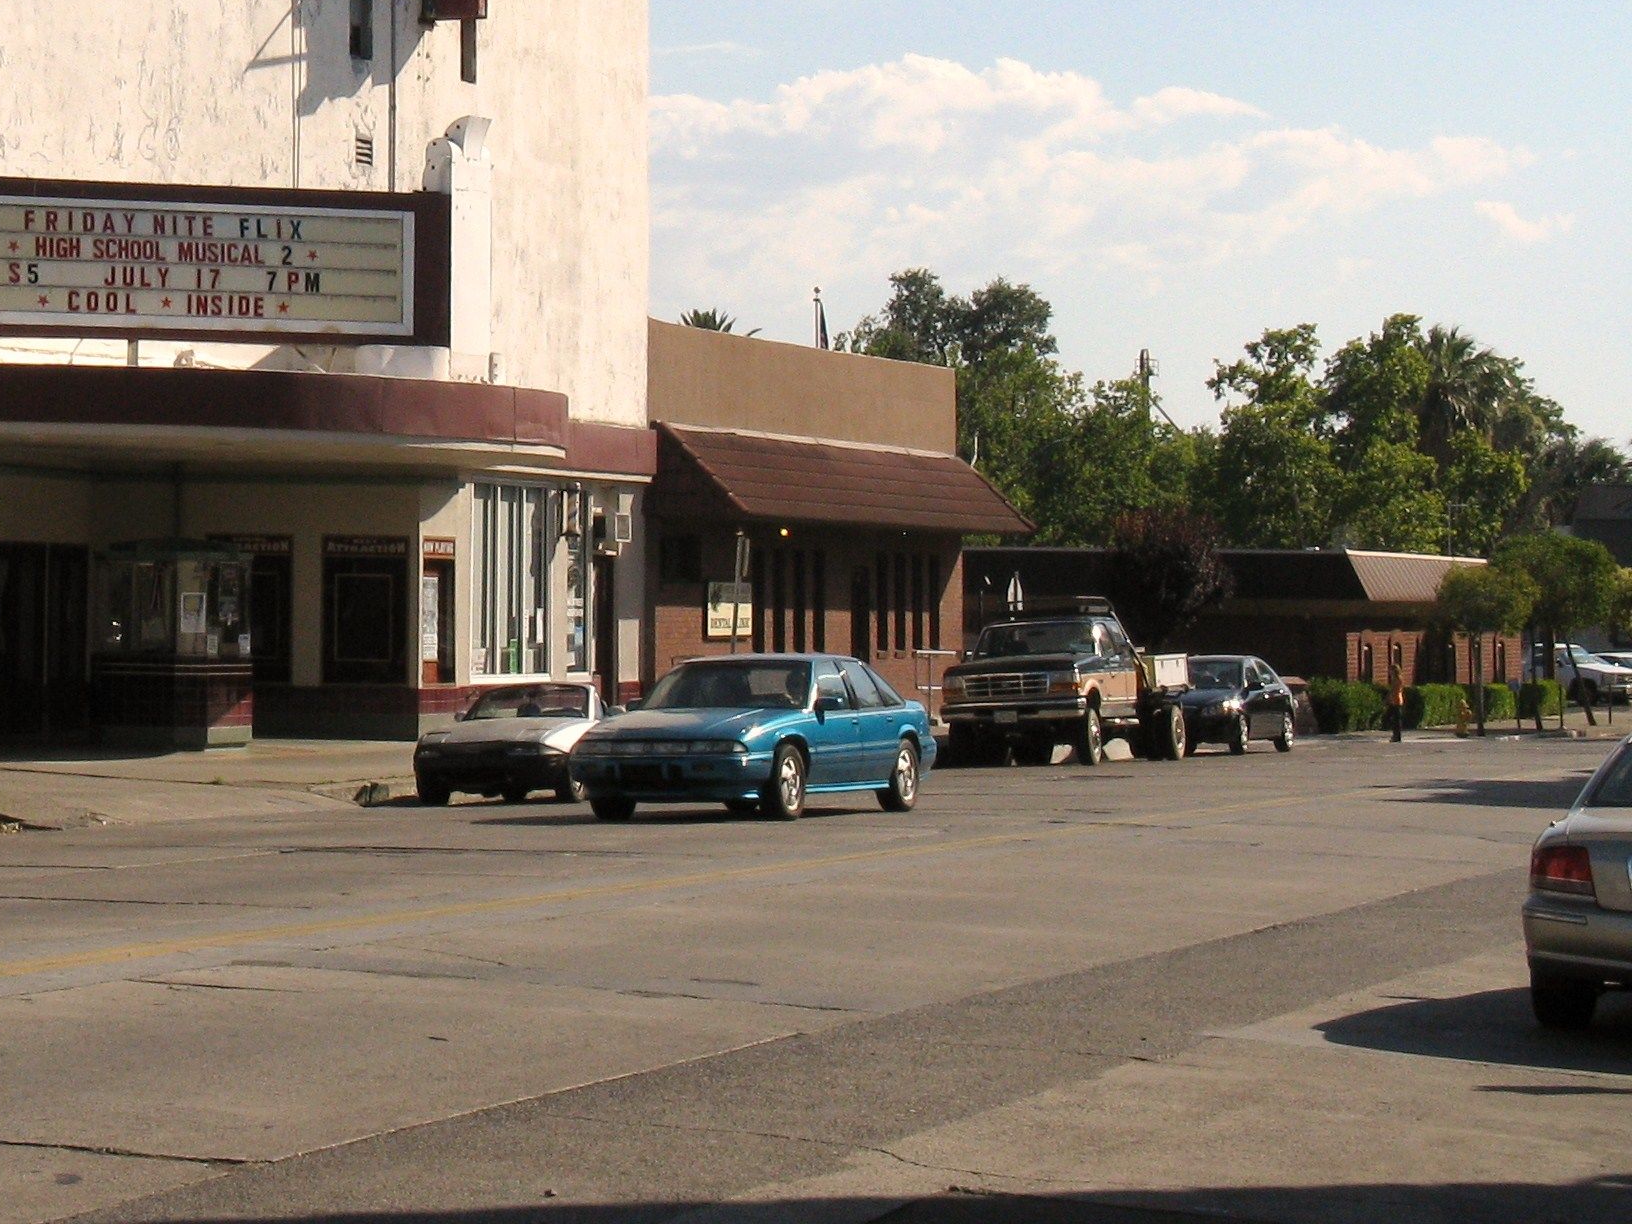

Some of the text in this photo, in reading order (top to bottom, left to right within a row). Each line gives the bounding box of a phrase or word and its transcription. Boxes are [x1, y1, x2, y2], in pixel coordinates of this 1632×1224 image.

[24, 209, 302, 240] FRIDAY NITE FLIX
[35, 236, 293, 266] HIGH SCHOOL MUSICAL 2
[104, 266, 169, 288] JULY
[196, 268, 221, 289] 17
[68, 290, 264, 317] COOL INSIDE
